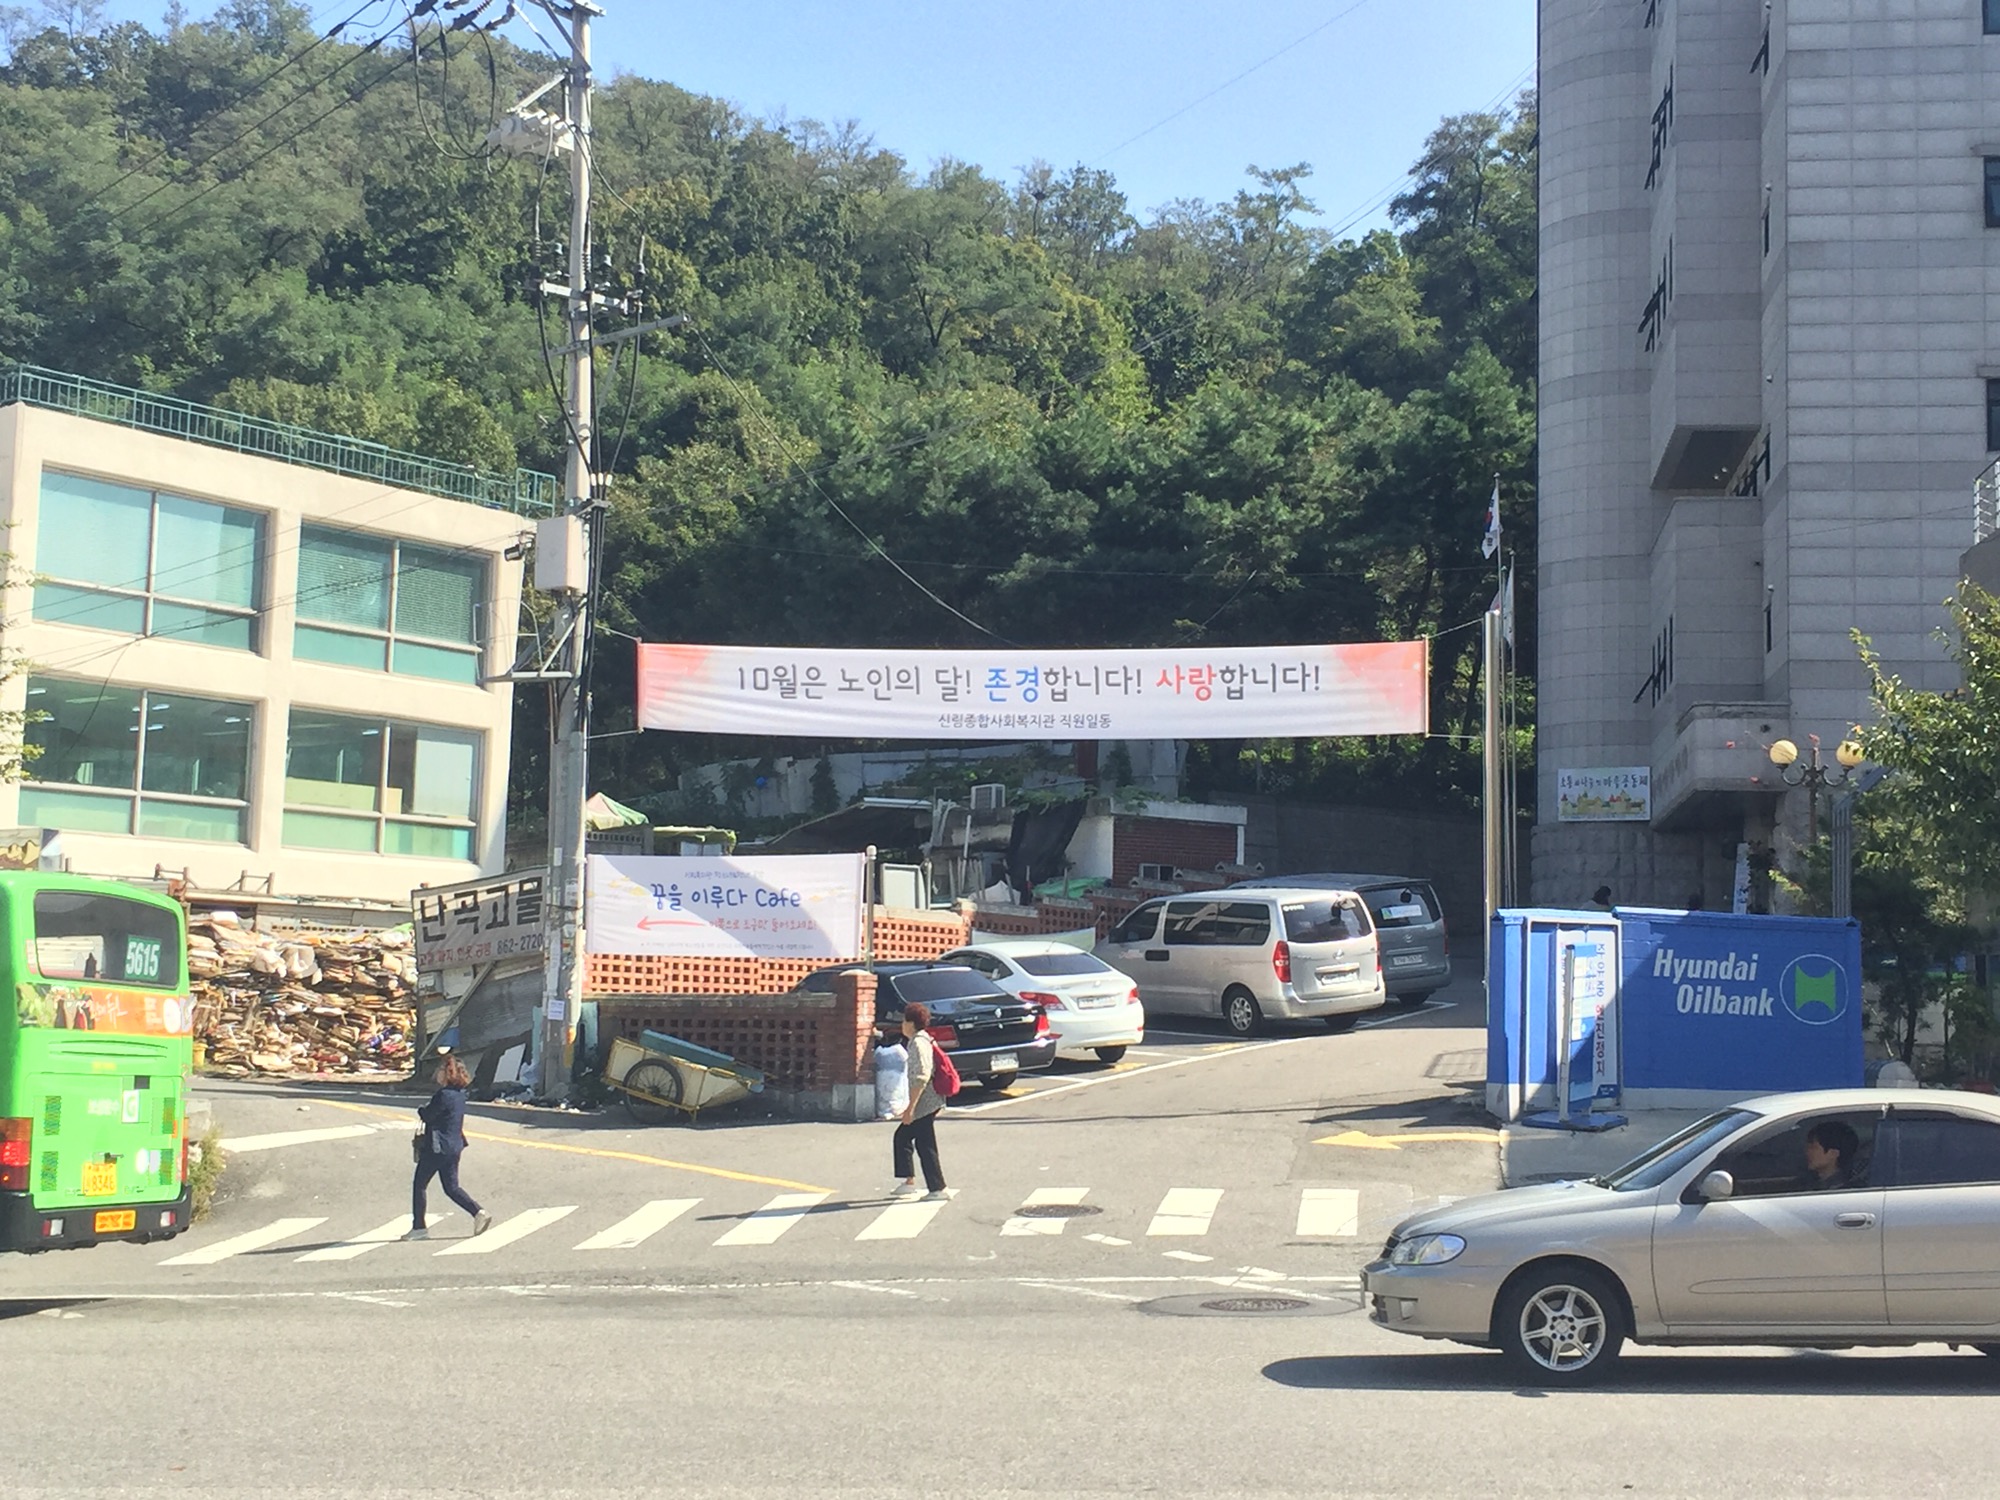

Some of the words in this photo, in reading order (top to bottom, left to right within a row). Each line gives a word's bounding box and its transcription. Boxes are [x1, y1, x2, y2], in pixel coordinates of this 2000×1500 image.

[737, 663, 828, 700] 10월은
[837, 665, 921, 702] 노인의
[935, 665, 972, 703] 달!
[984, 664, 1142, 703] 존경합니다!
[1155, 662, 1321, 703] 사랑합니다!
[938, 713, 1055, 729] 신림종합사회복지관
[1059, 714, 1112, 729] 직원일동
[420, 876, 543, 943] 난곡고물
[650, 883, 683, 911] 꿈을
[691, 884, 748, 909] 이루다
[755, 886, 802, 908] Cafe
[126, 941, 161, 977] 5615
[497, 933, 543, 955] 862-2720
[1596, 943, 1605, 998] 주유중
[1653, 948, 1759, 984] Hyundai
[1676, 983, 1775, 1017] Oilbank
